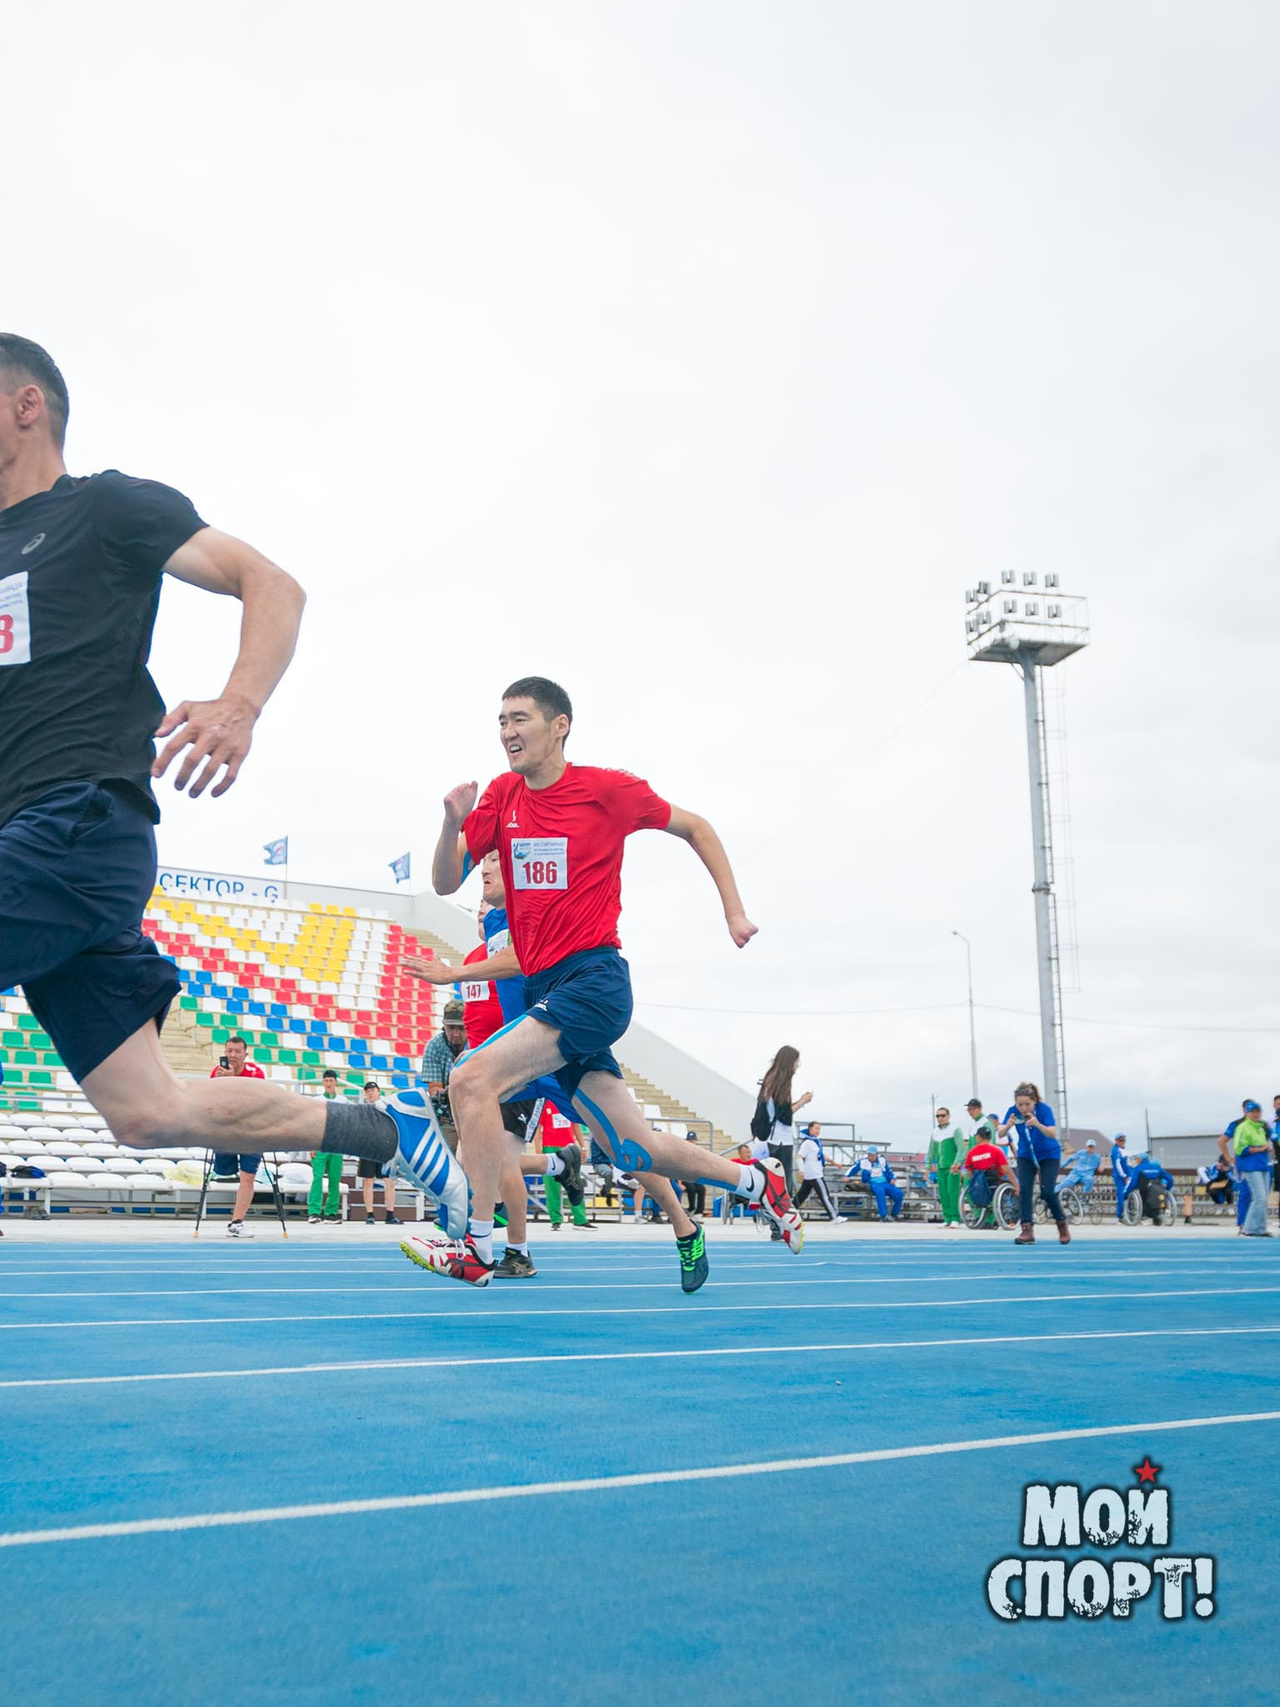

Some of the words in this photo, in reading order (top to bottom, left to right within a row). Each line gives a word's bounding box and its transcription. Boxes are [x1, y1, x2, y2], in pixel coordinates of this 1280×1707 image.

[159, 872, 245, 897] СЕКТОР
[522, 861, 558, 885] 186
[466, 984, 481, 999] 147
